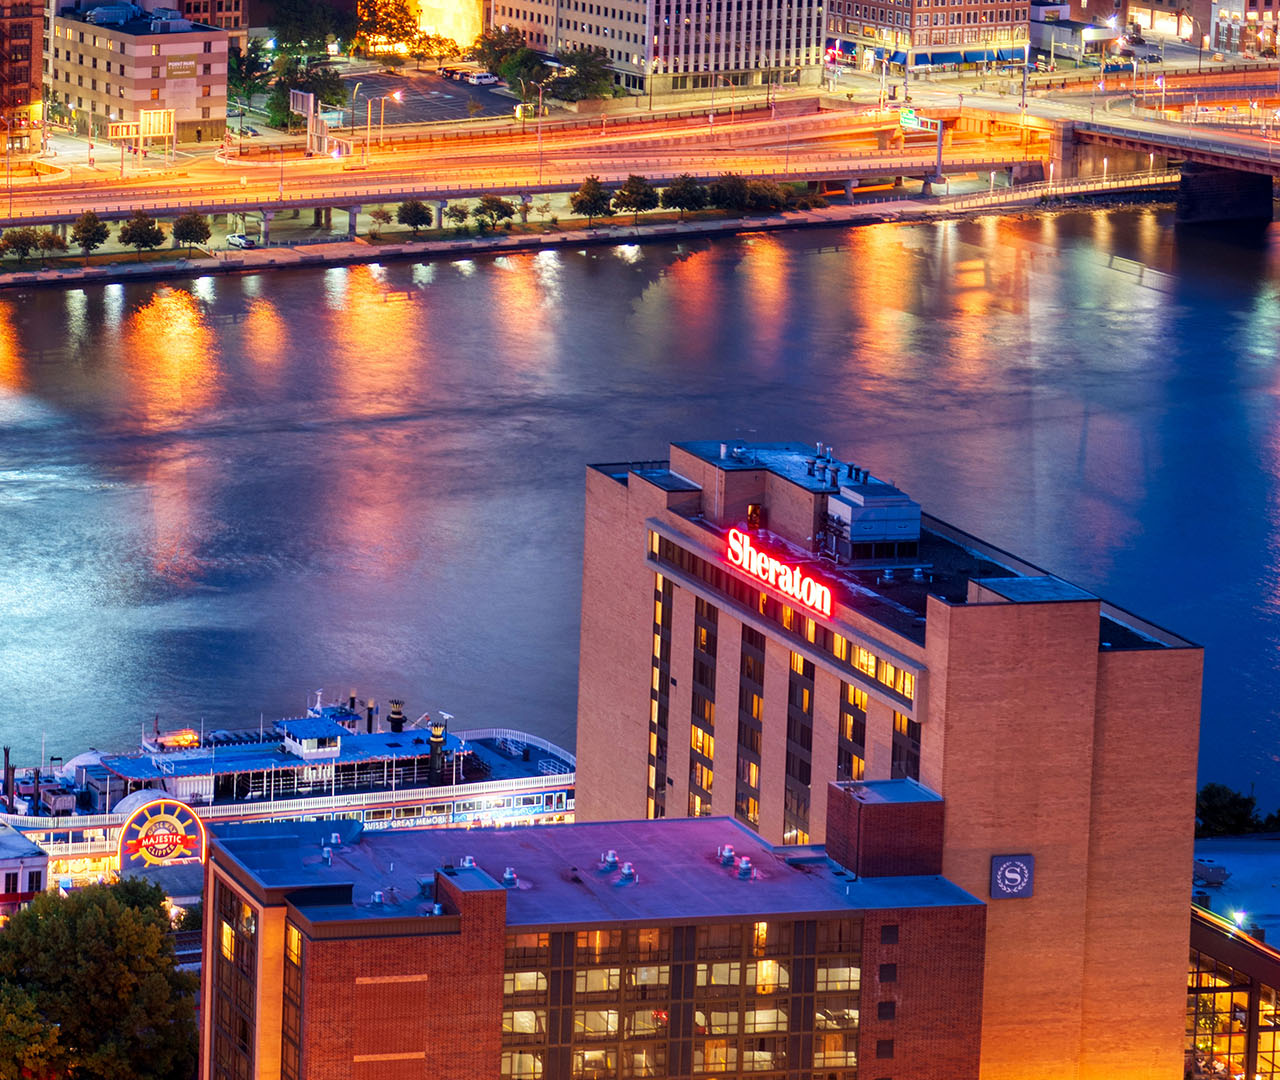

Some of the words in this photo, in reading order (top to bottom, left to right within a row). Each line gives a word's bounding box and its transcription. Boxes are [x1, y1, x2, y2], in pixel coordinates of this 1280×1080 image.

[727, 528, 832, 617] Sheraton
[147, 821, 178, 836] GATEWAY
[363, 821, 388, 831] RUISES
[391, 819, 415, 828] GREAT
[141, 834, 182, 846] MAJESTIC
[147, 843, 176, 856] CLIPPER
[1005, 866, 1021, 886] S
